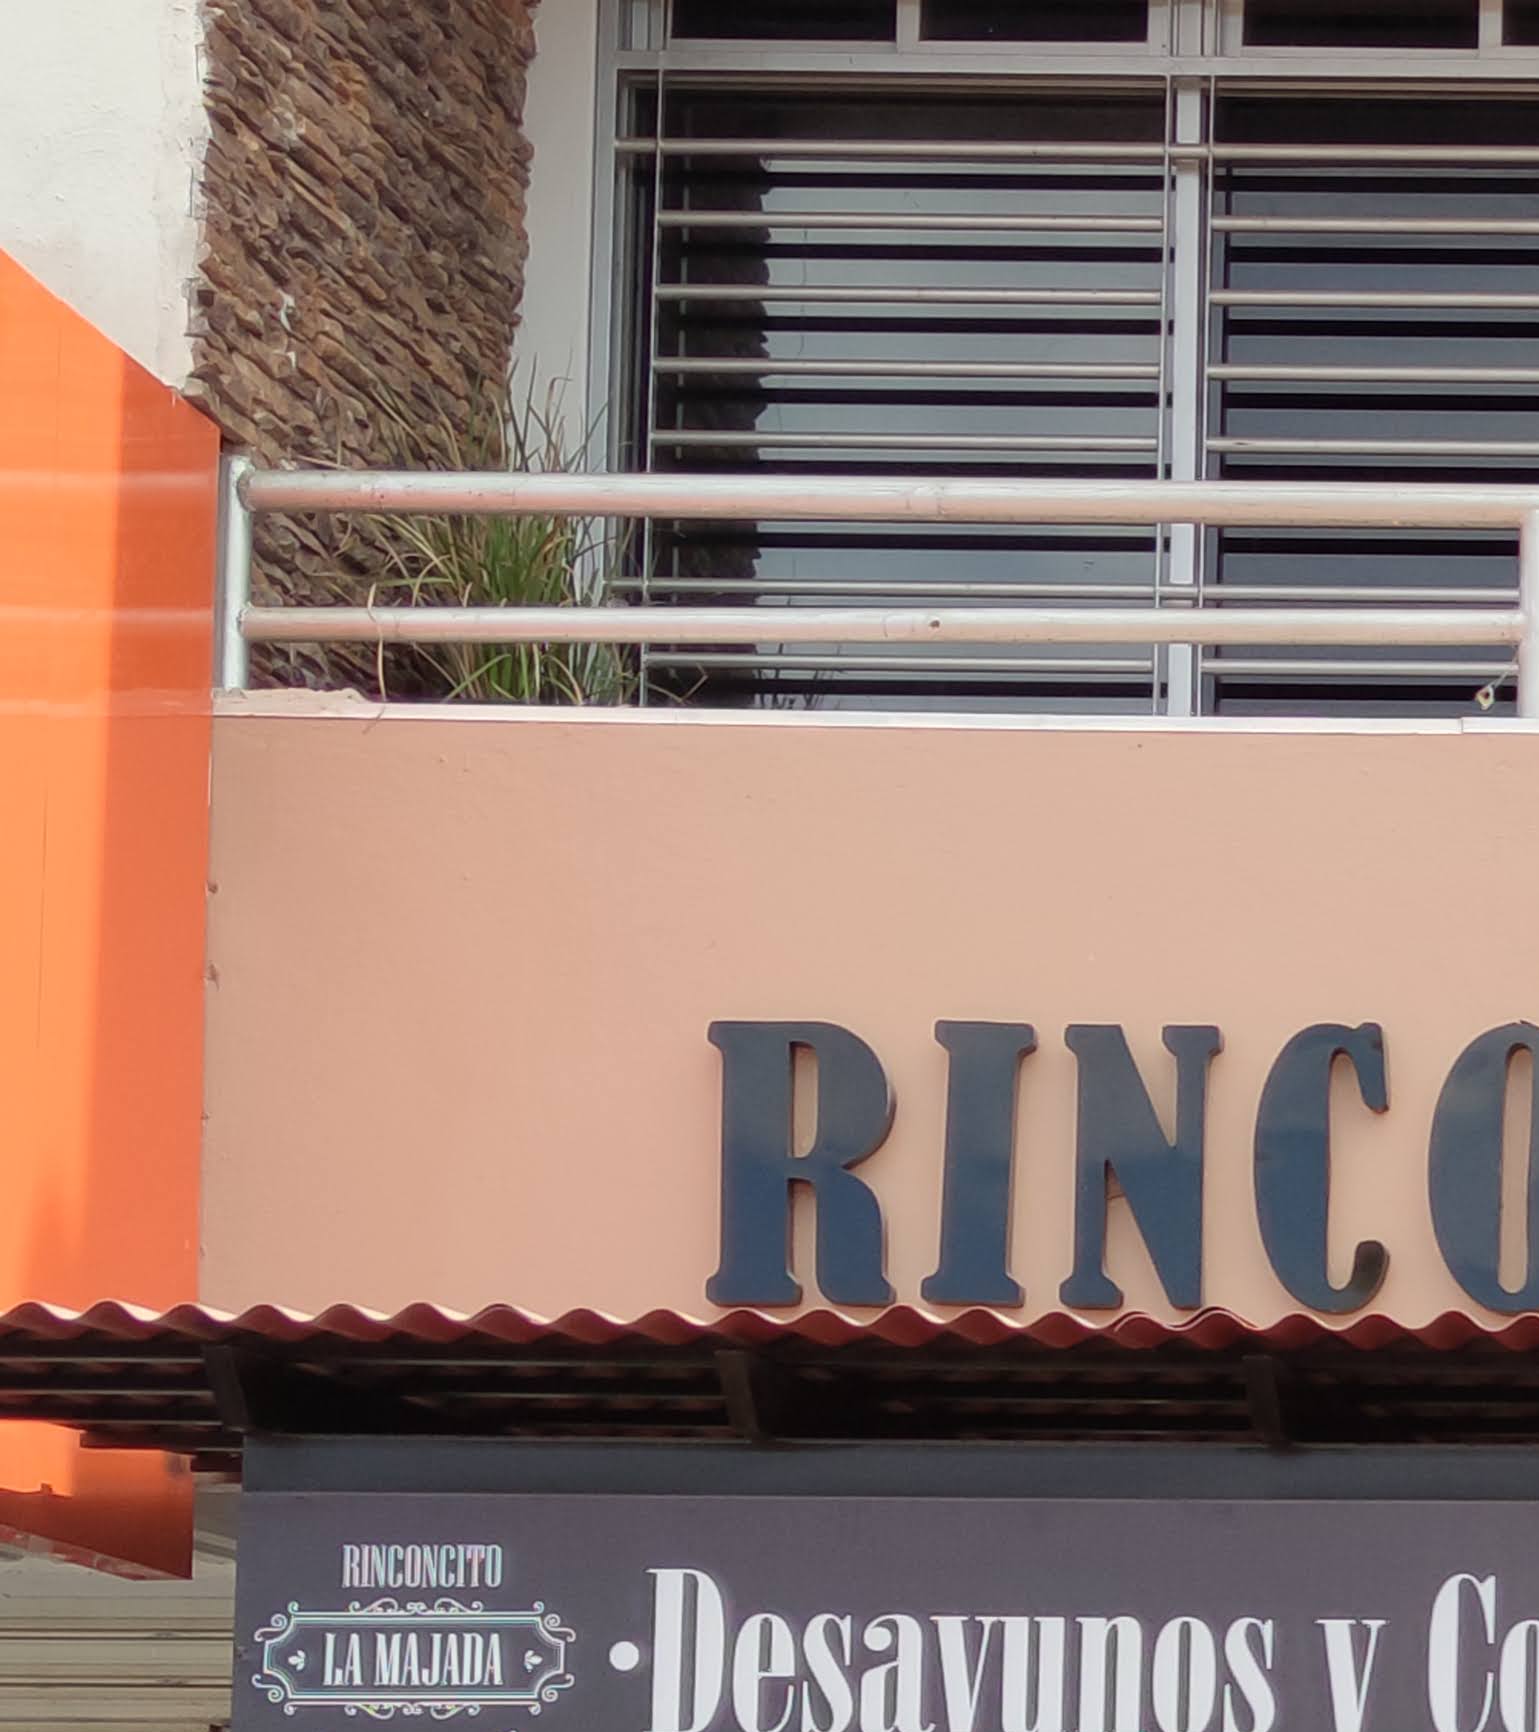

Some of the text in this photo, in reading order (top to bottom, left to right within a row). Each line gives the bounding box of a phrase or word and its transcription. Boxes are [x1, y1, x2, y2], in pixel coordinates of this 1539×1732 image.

[342, 1544, 503, 1589] RINCONCITO
[323, 1632, 503, 1686] LA MAJADA
